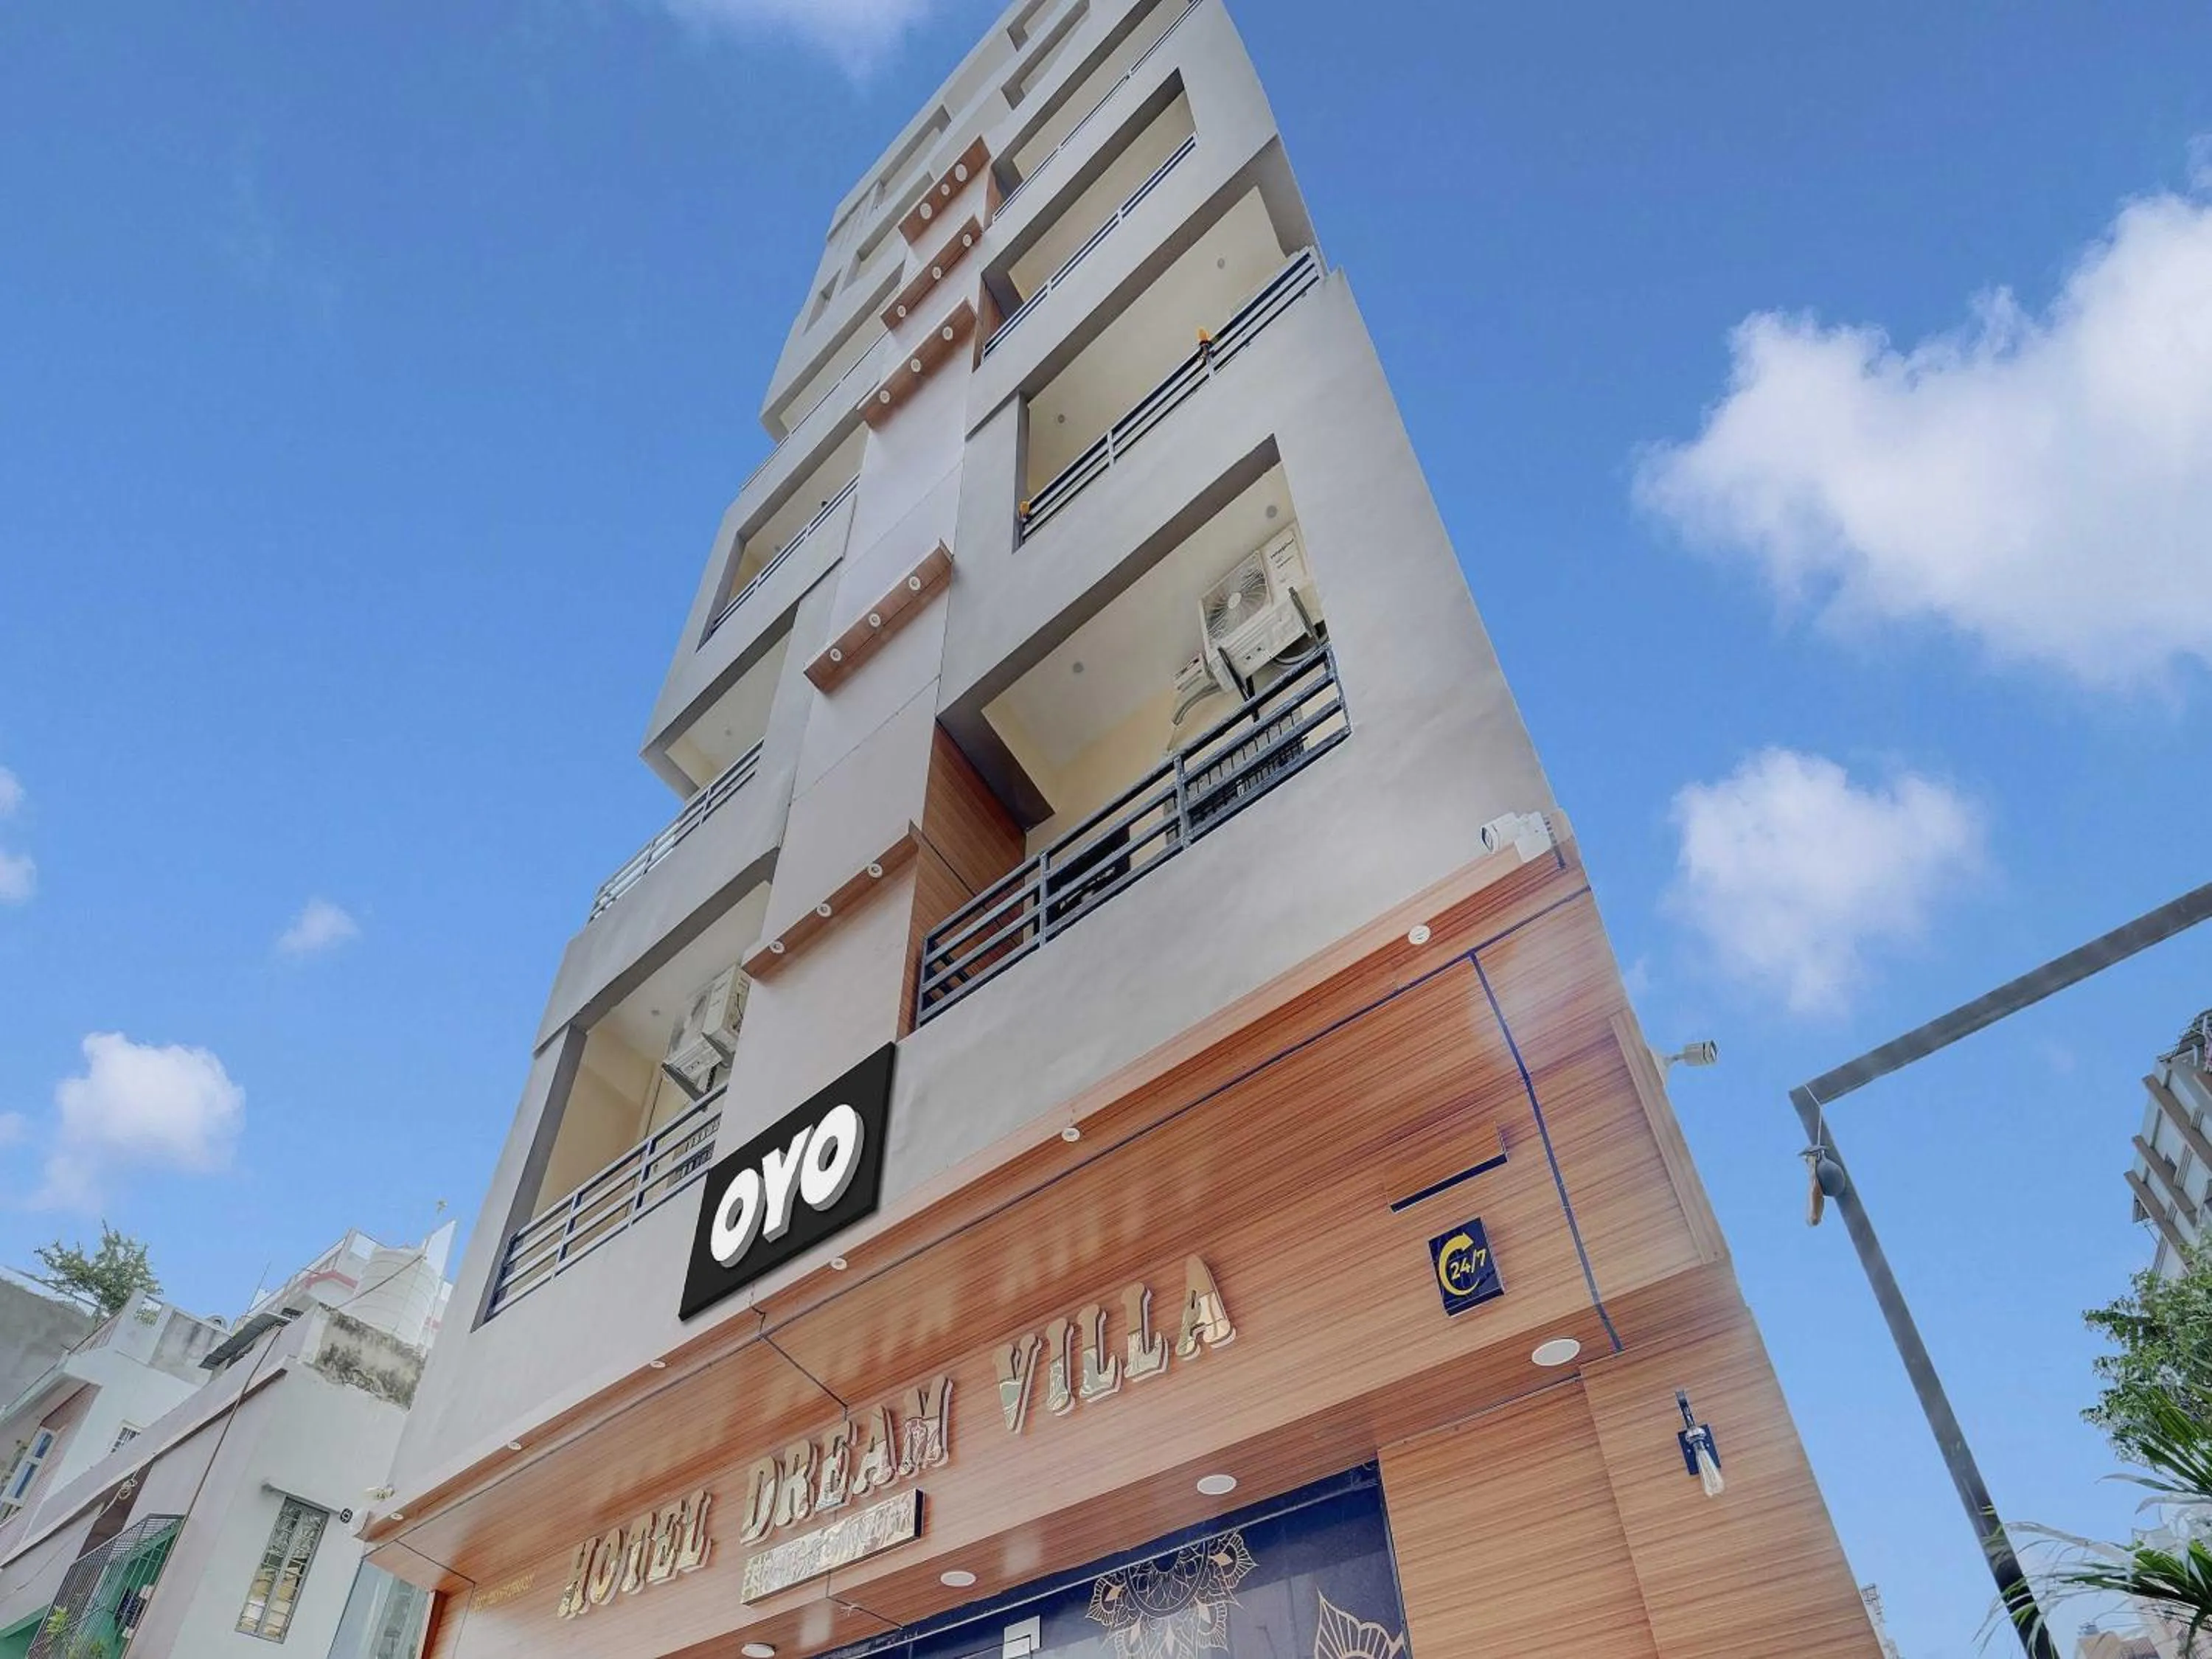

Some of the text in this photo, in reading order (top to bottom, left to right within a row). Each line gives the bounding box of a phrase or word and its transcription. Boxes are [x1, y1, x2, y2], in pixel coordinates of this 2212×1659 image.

[711, 1104, 864, 1268] OYO
[1450, 1248, 1486, 1280] 24/7
[557, 1489, 712, 1619] HOTEL
[740, 1374, 953, 1547] DREAM
[992, 1254, 1237, 1435] VILLA
